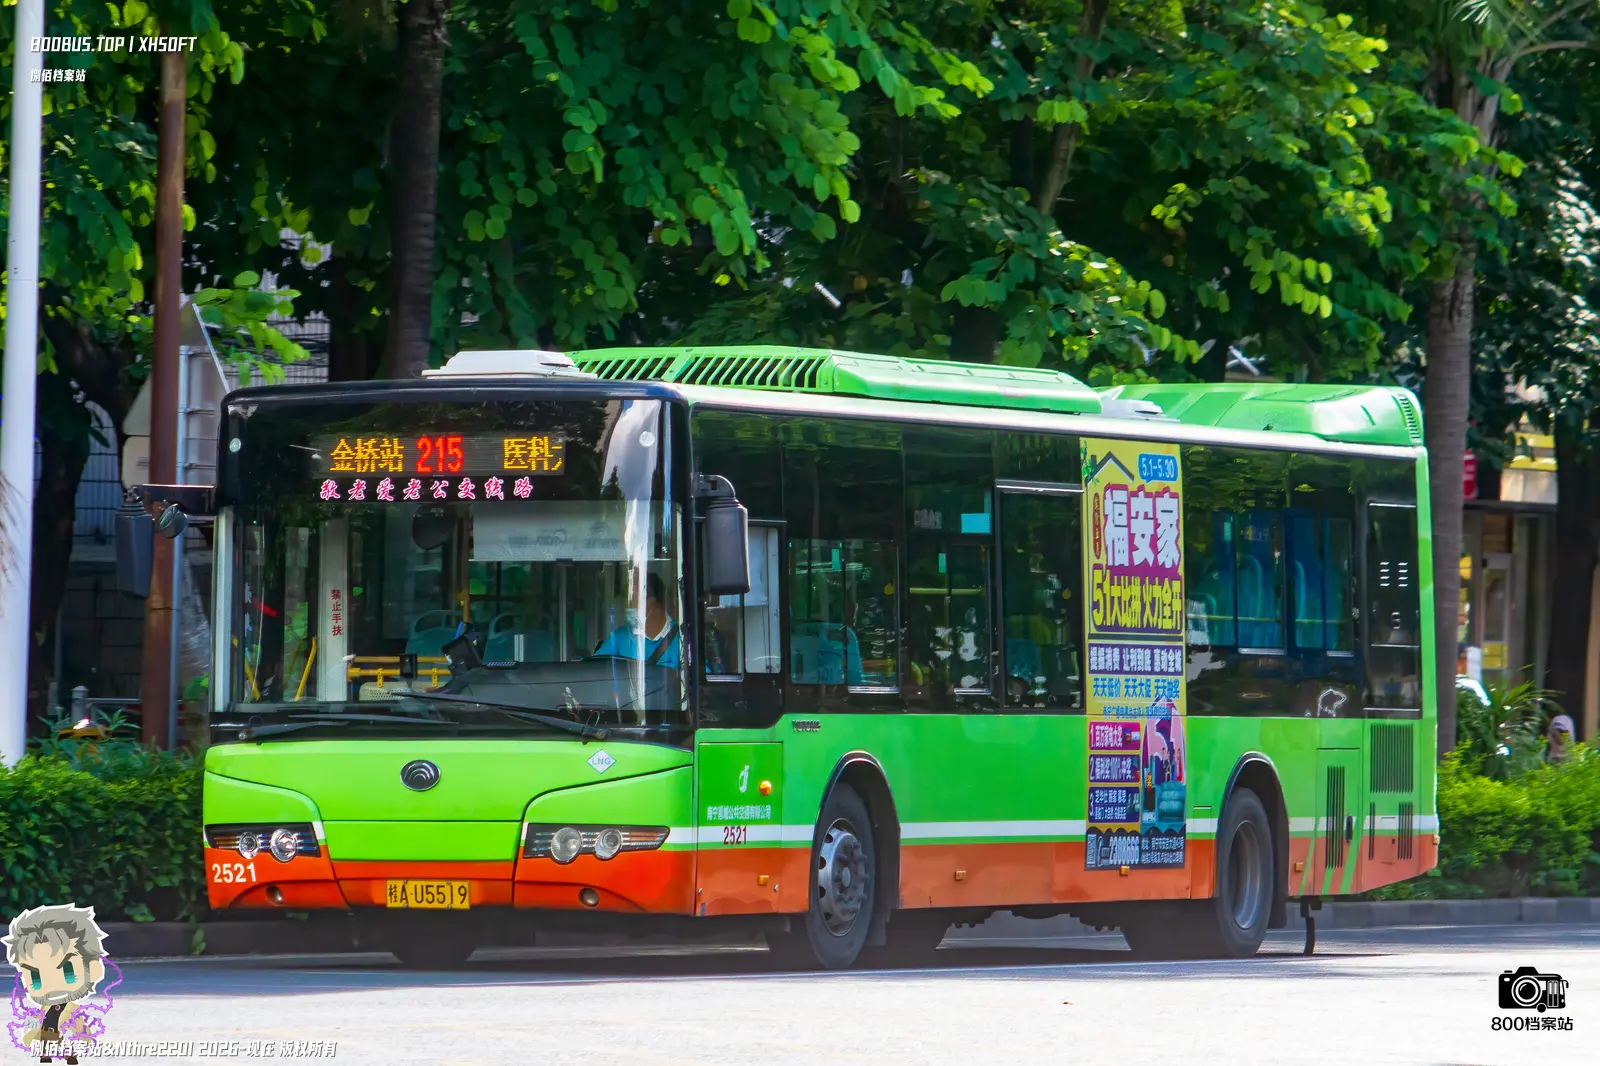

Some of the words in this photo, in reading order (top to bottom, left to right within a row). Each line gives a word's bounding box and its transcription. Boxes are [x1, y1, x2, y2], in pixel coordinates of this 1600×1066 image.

[329, 438, 404, 473] 金桥站
[415, 435, 464, 473] 215
[1141, 457, 1175, 478] 5.1-5.30
[320, 476, 533, 501] 敬老爱老公交线路
[1103, 486, 1181, 569] 福安家
[331, 589, 343, 636] 禁止手扶
[1142, 576, 1182, 630] 火力全开
[1123, 647, 1151, 672] 让利到底
[592, 757, 611, 770] LNG
[723, 825, 748, 845] 2521
[211, 862, 257, 884] 2521
